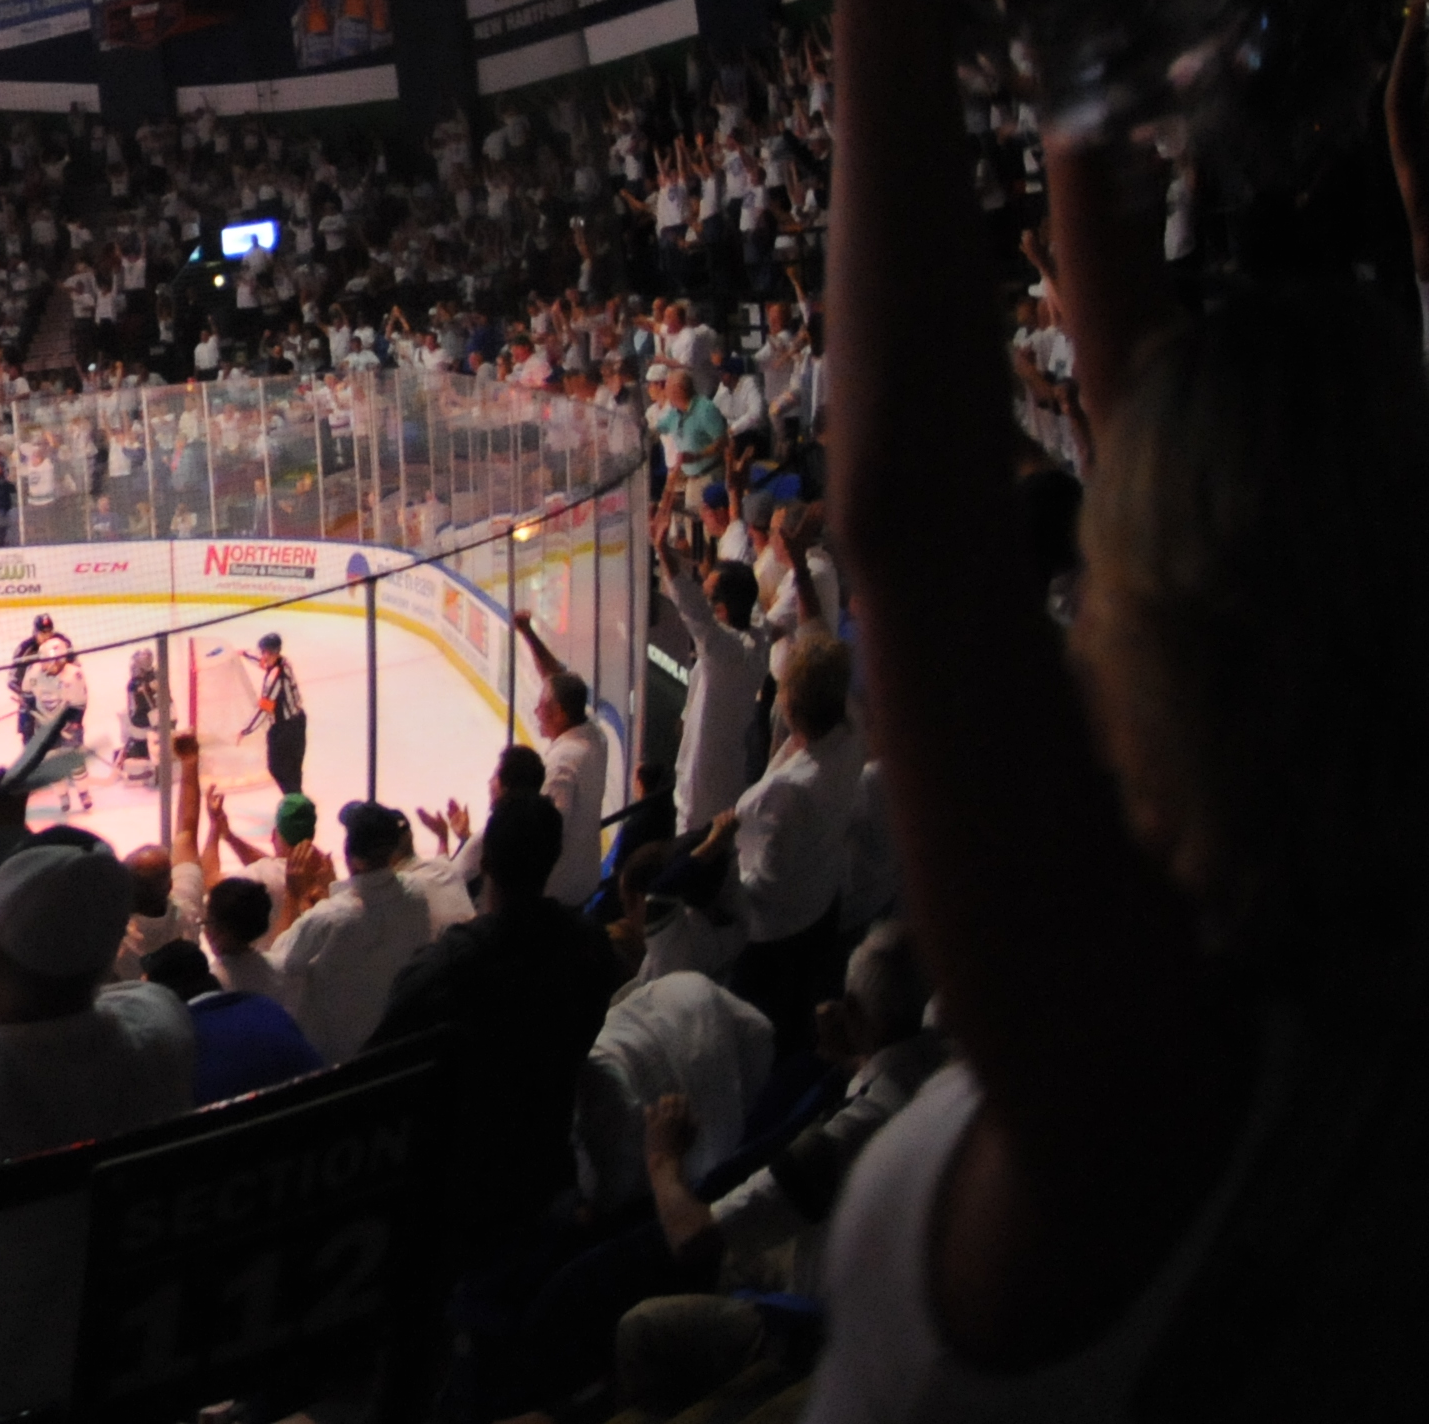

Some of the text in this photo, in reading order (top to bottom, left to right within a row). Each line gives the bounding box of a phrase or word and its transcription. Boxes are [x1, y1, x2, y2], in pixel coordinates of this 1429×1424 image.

[73, 561, 130, 574] CCM
[203, 544, 318, 577] NORTHERN
[118, 1114, 413, 1253] SECTION
[108, 1216, 391, 1399] 112
